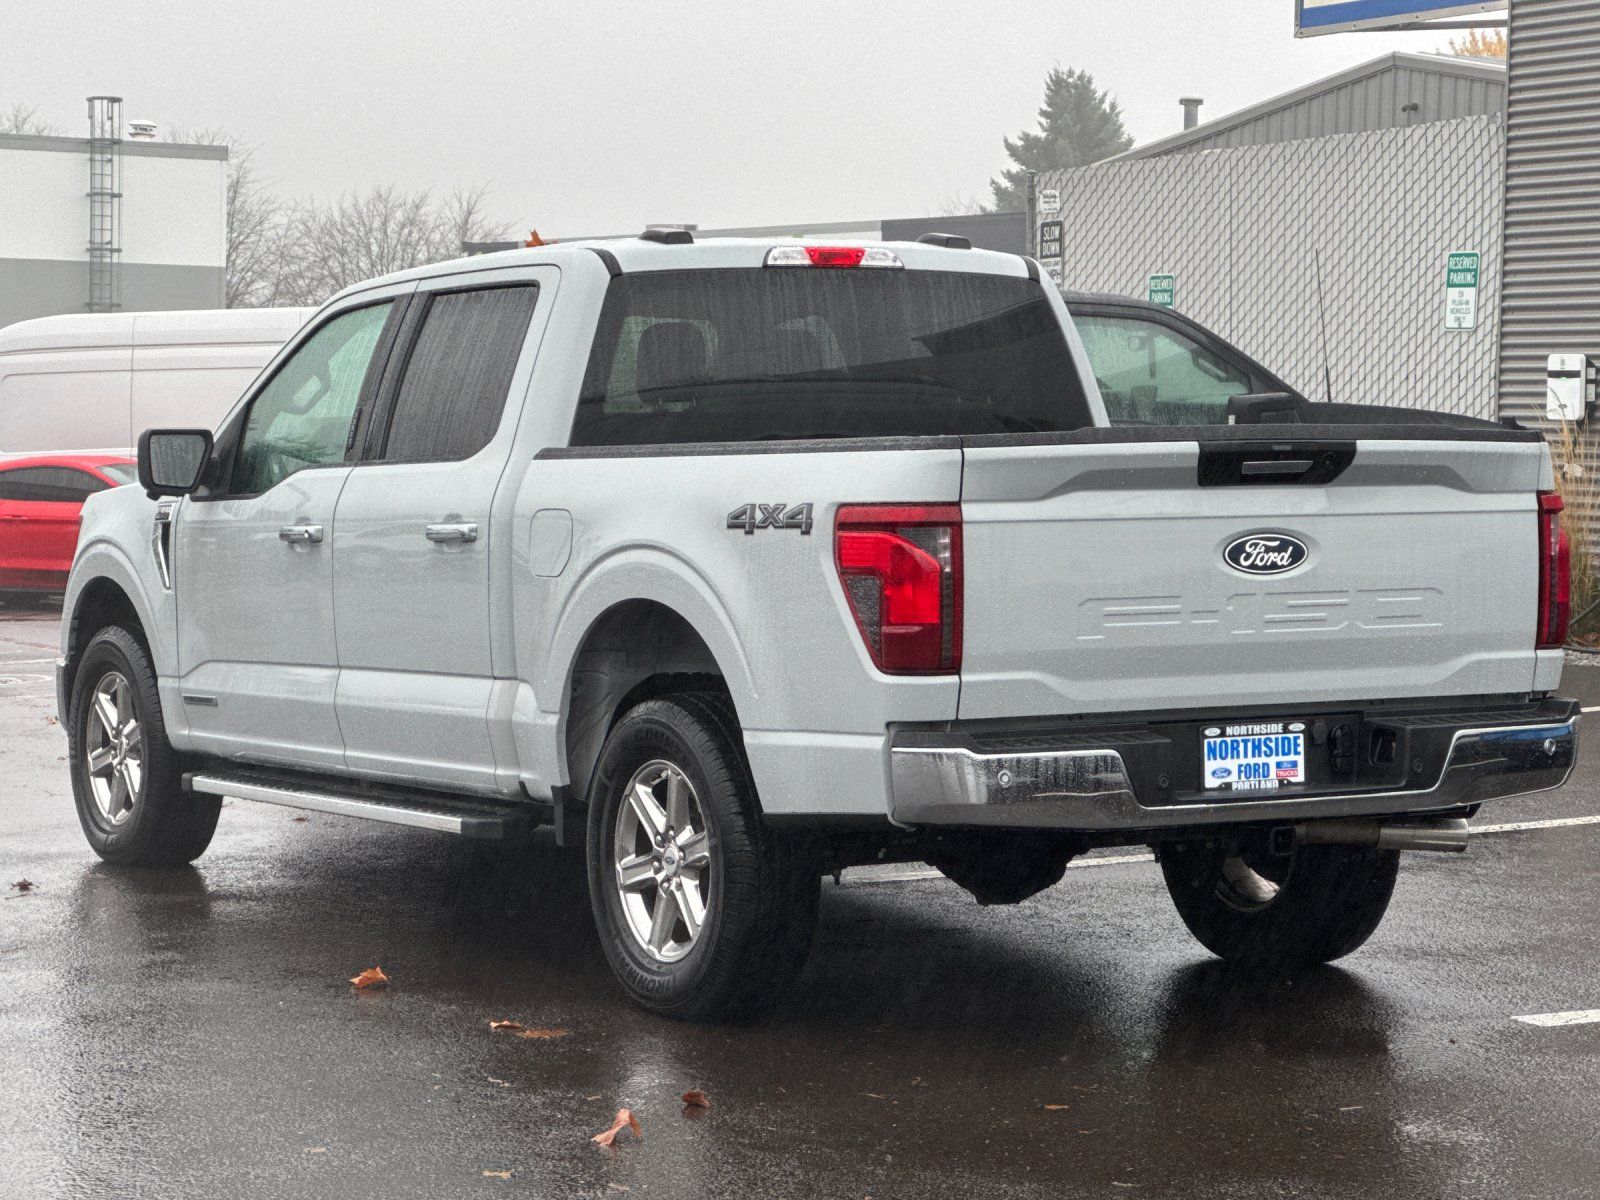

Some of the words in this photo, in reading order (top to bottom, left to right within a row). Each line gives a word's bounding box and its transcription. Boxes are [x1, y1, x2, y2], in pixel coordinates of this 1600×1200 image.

[1043, 226, 1060, 240] SLOW
[1042, 241, 1060, 256] DOWN
[1449, 256, 1478, 270] RESERVED
[1151, 279, 1173, 290] RESERVED
[1449, 271, 1475, 285] PARKING
[1151, 291, 1171, 303] PARKING
[1239, 539, 1292, 567] Ford
[1226, 724, 1284, 736] NORTHSIDE
[1206, 736, 1301, 761] NORTHSIDE
[1237, 762, 1270, 780] FORD
[1277, 769, 1298, 777] TRUCKS
